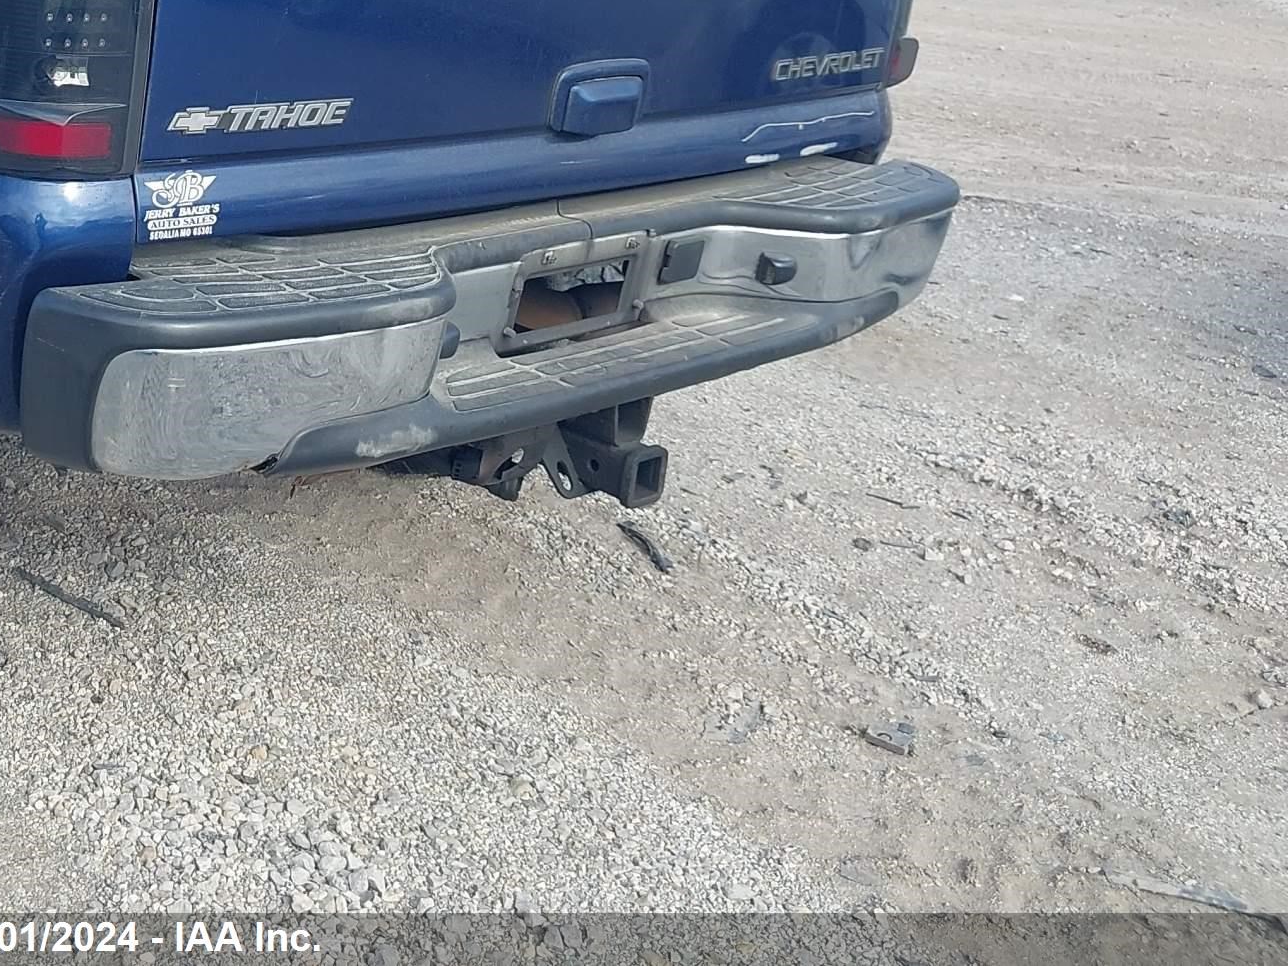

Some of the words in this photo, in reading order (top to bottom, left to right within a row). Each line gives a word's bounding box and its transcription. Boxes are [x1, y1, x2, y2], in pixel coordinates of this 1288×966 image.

[775, 47, 885, 80] CHEVROLET
[227, 99, 353, 132] TAHOE
[143, 208, 176, 222] JERRY
[179, 203, 220, 217] BAKER'S
[150, 219, 181, 229] AUTO
[183, 215, 215, 226] SALES
